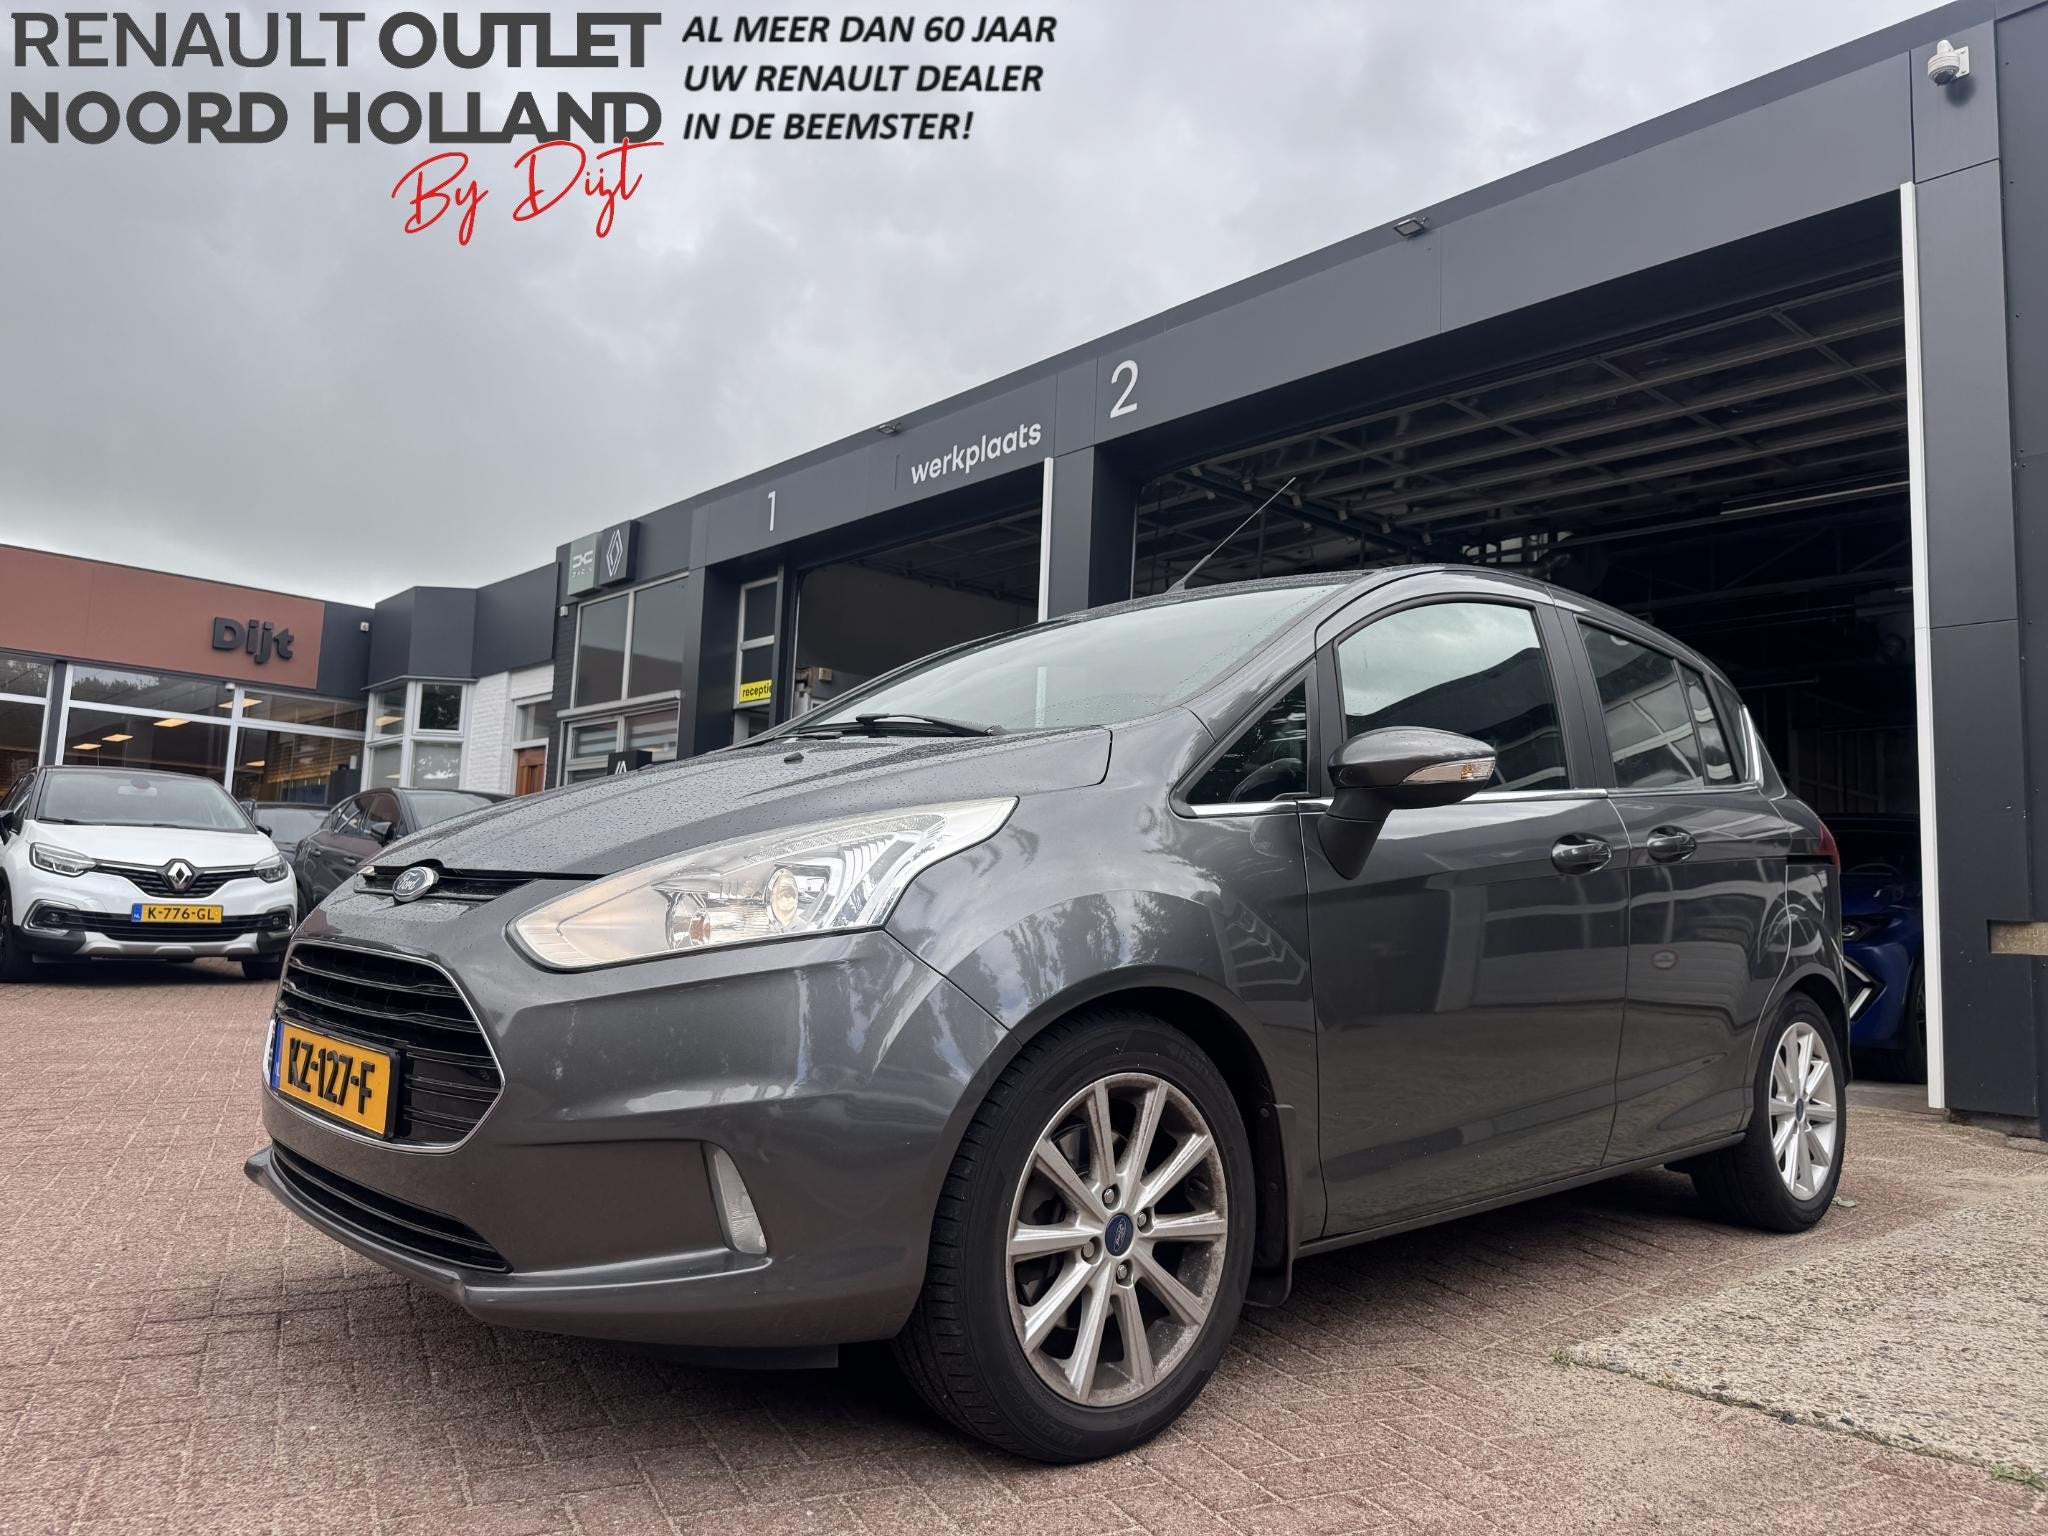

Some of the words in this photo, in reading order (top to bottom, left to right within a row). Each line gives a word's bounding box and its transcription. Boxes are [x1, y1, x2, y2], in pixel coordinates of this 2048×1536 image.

[1110, 360, 1139, 419] 2
[911, 423, 1042, 484] werkplaats
[768, 490, 776, 531] 1
[212, 616, 295, 664] Dijt
[742, 683, 772, 697] recepti
[147, 907, 215, 920] K-776-GL
[287, 1037, 375, 1115] KZ-127-F
